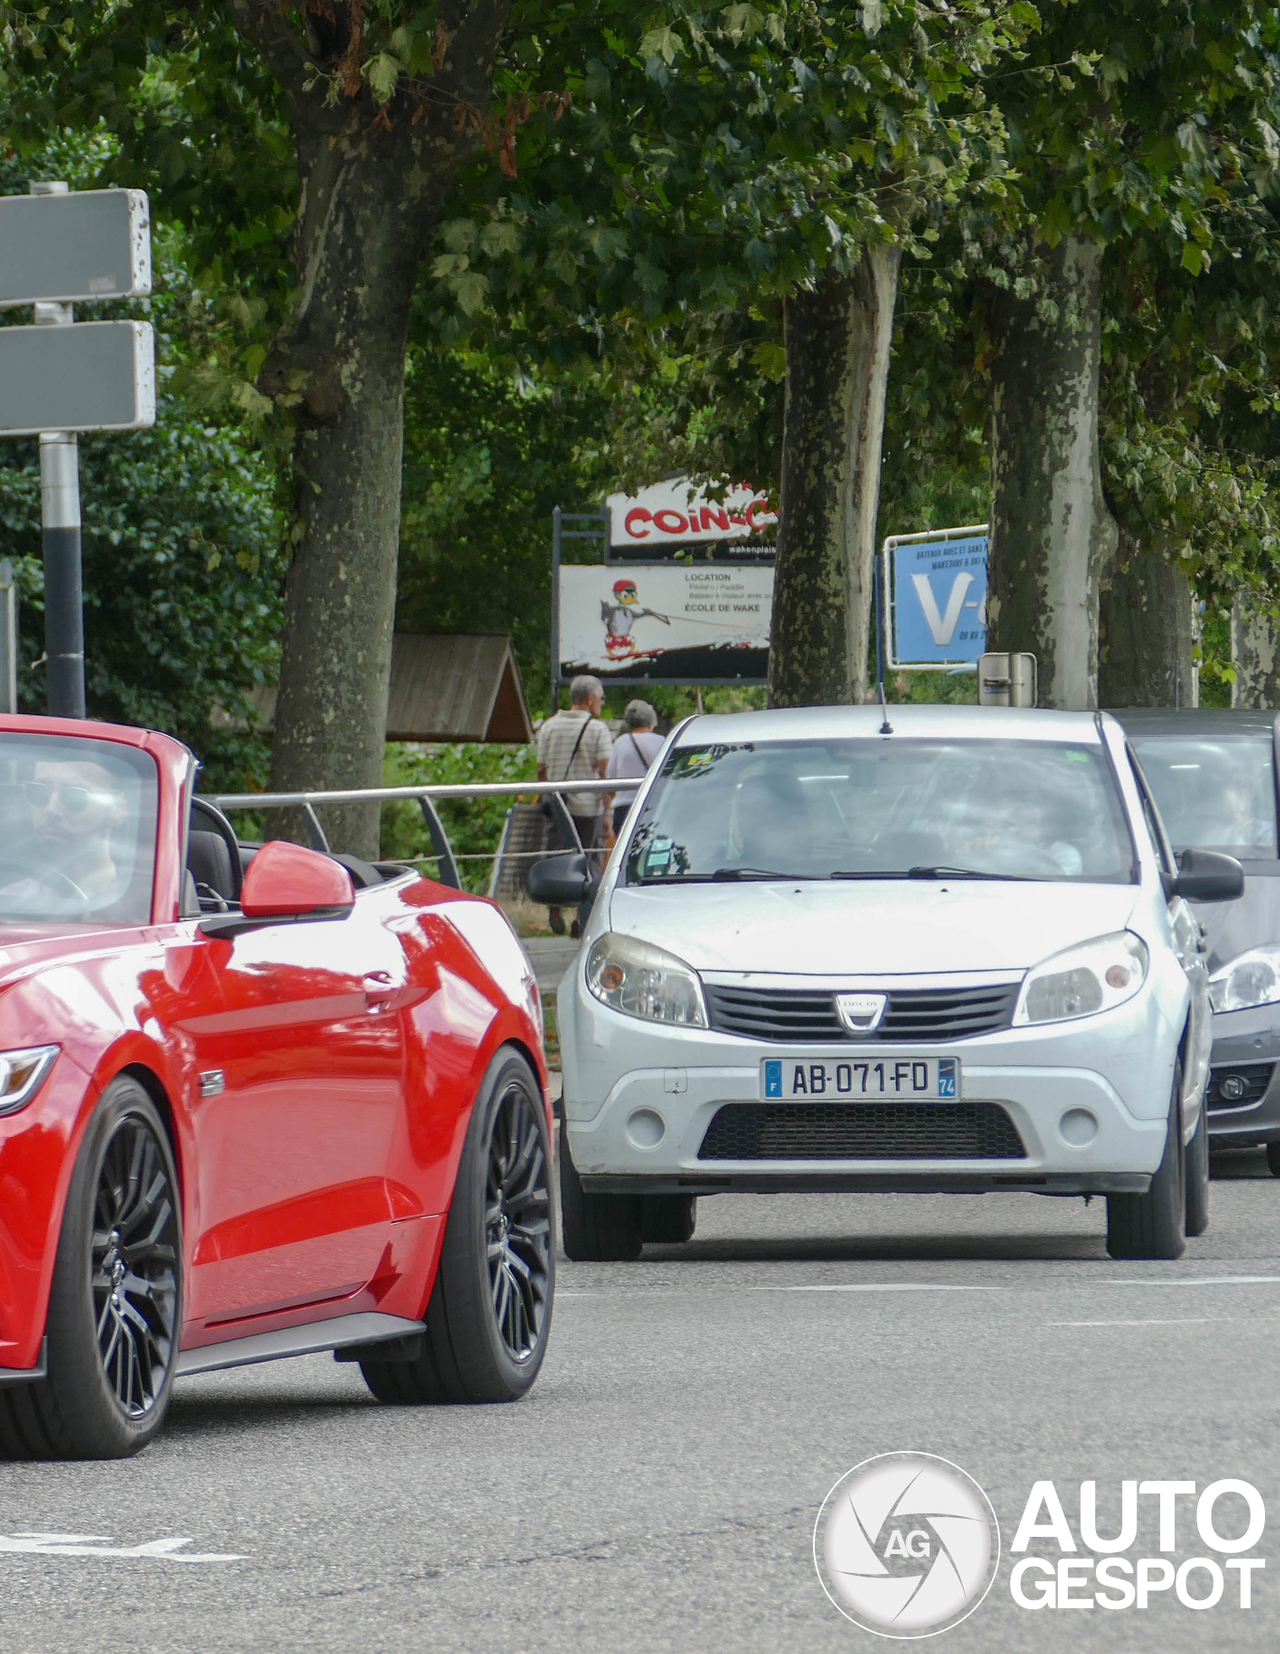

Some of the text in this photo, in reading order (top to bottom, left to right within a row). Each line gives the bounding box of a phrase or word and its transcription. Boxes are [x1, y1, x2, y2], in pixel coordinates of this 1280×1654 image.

[916, 549, 942, 560] BATEAUX
[943, 547, 958, 557] AVEC
[959, 545, 966, 554] ET
[967, 543, 983, 554] SANS
[684, 573, 731, 582] LOCATION
[718, 603, 731, 612] DE
[733, 603, 761, 612] WAKE
[770, 1061, 955, 1094] F AB-071-FD 74
